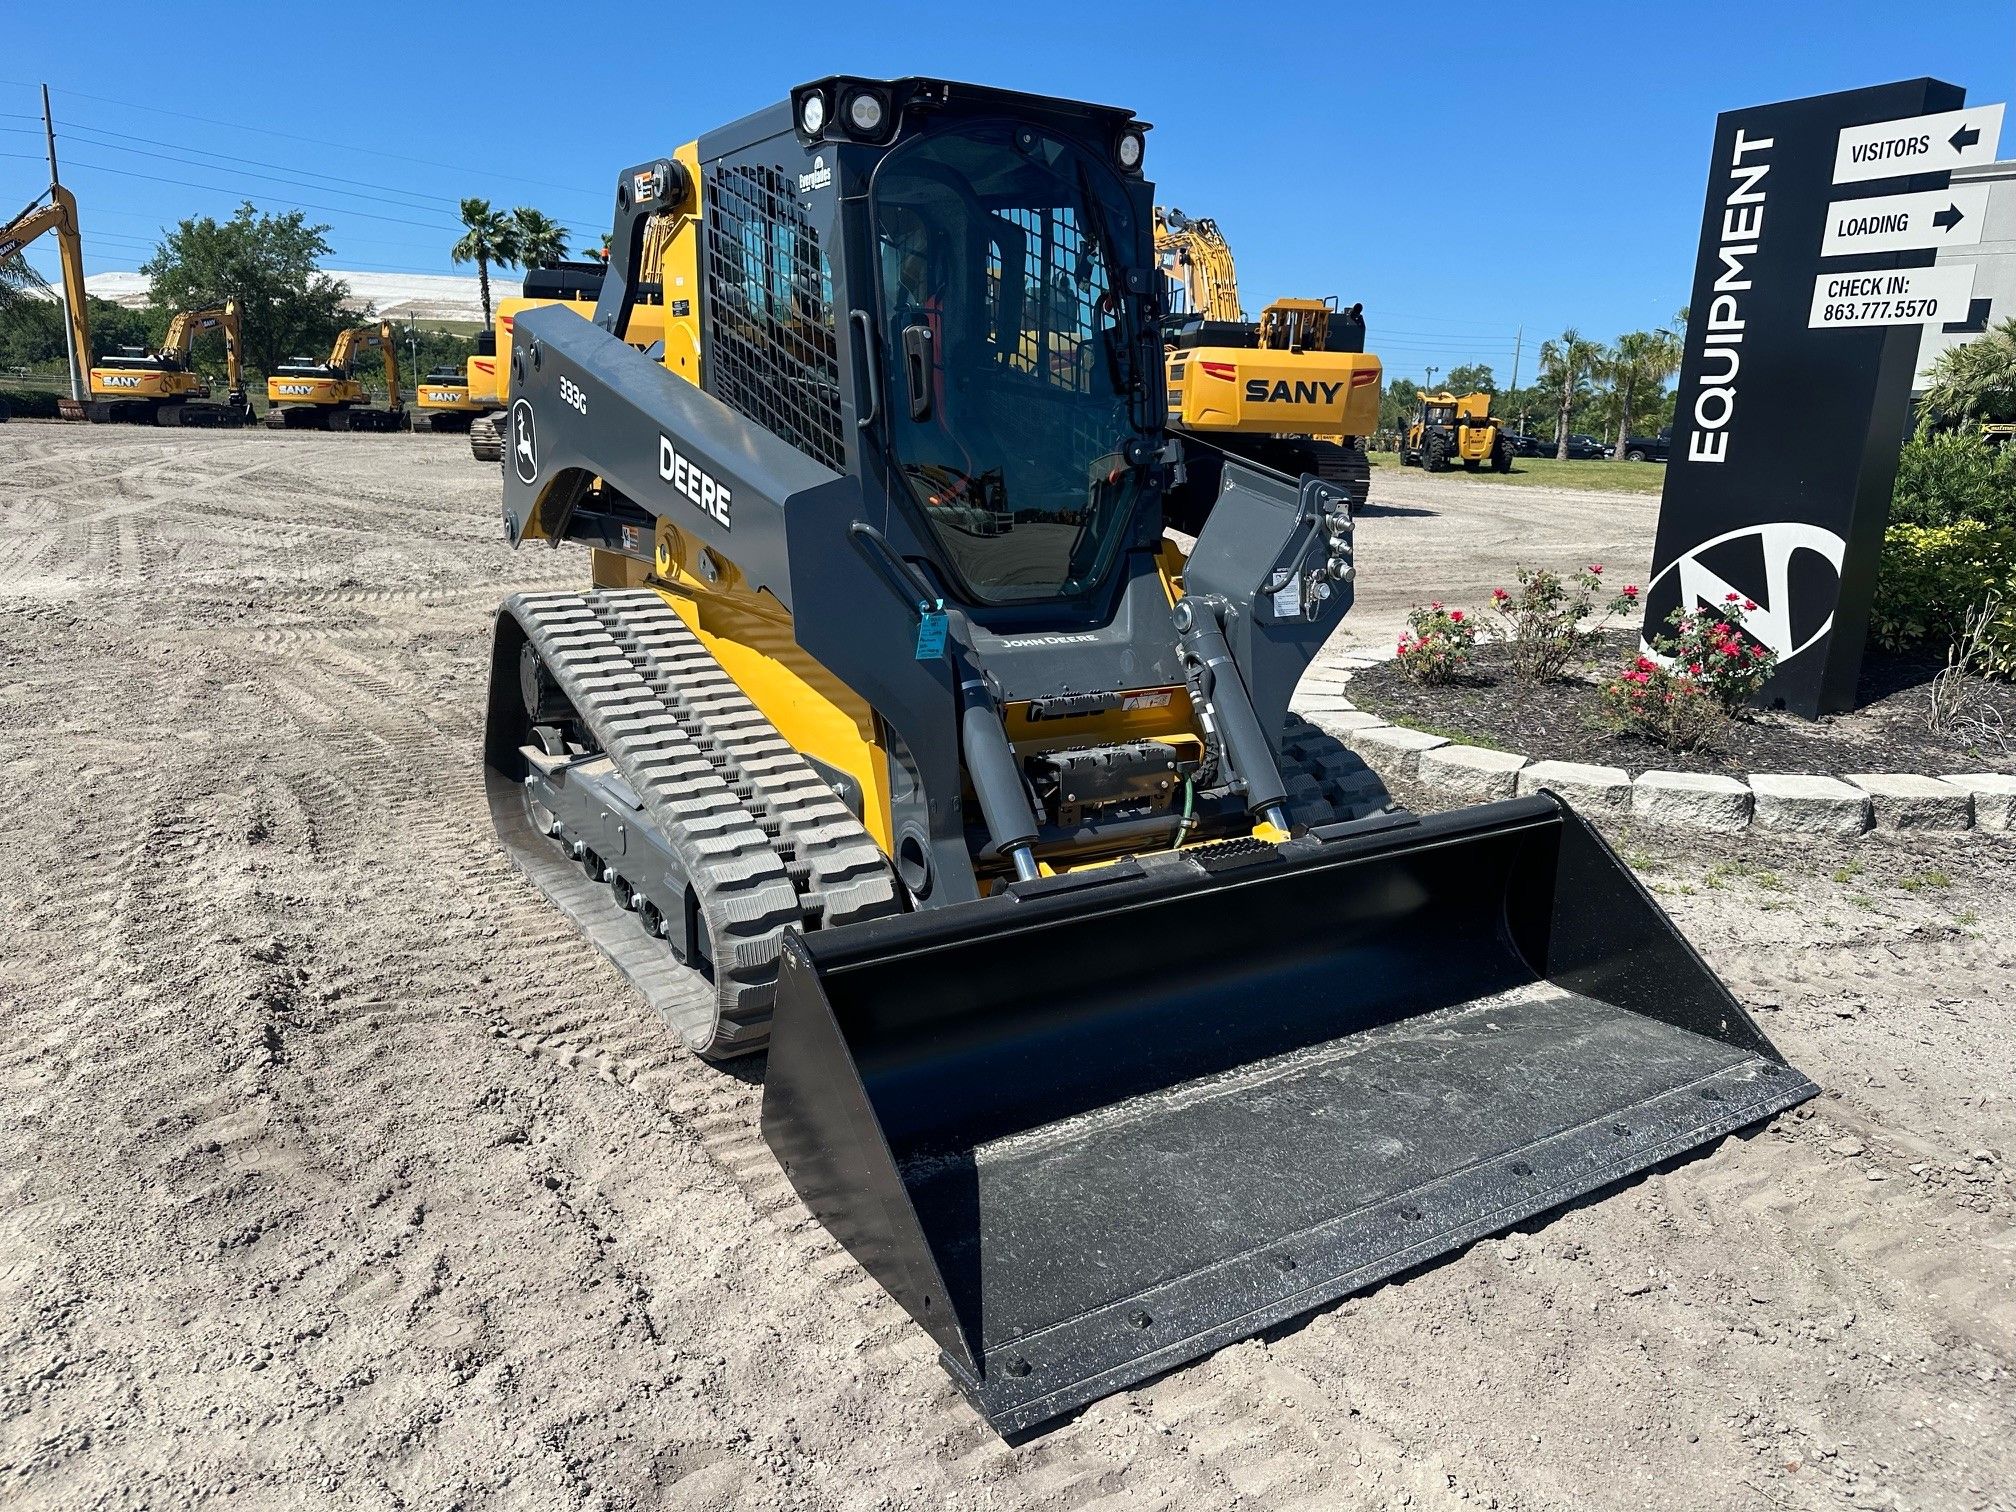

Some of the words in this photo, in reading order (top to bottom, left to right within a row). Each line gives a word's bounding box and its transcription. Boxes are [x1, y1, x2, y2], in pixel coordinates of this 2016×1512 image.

[1852, 135, 1930, 163] VISITORS
[1837, 213, 1909, 237] LOADING
[1688, 129, 1774, 463] EQUIPMENT
[1828, 277, 1884, 298] CHECK
[1886, 276, 1910, 295] IN:
[1823, 298, 1938, 321] 863.777.5570
[103, 377, 141, 387] SANY
[278, 385, 315, 395] SANY
[1246, 379, 1345, 405] SANY
[428, 392, 462, 402] SANY
[560, 375, 587, 415] 333G
[659, 434, 732, 528] DEERE
[1002, 638, 1045, 648] JOHN
[1044, 634, 1099, 644] DEERE
